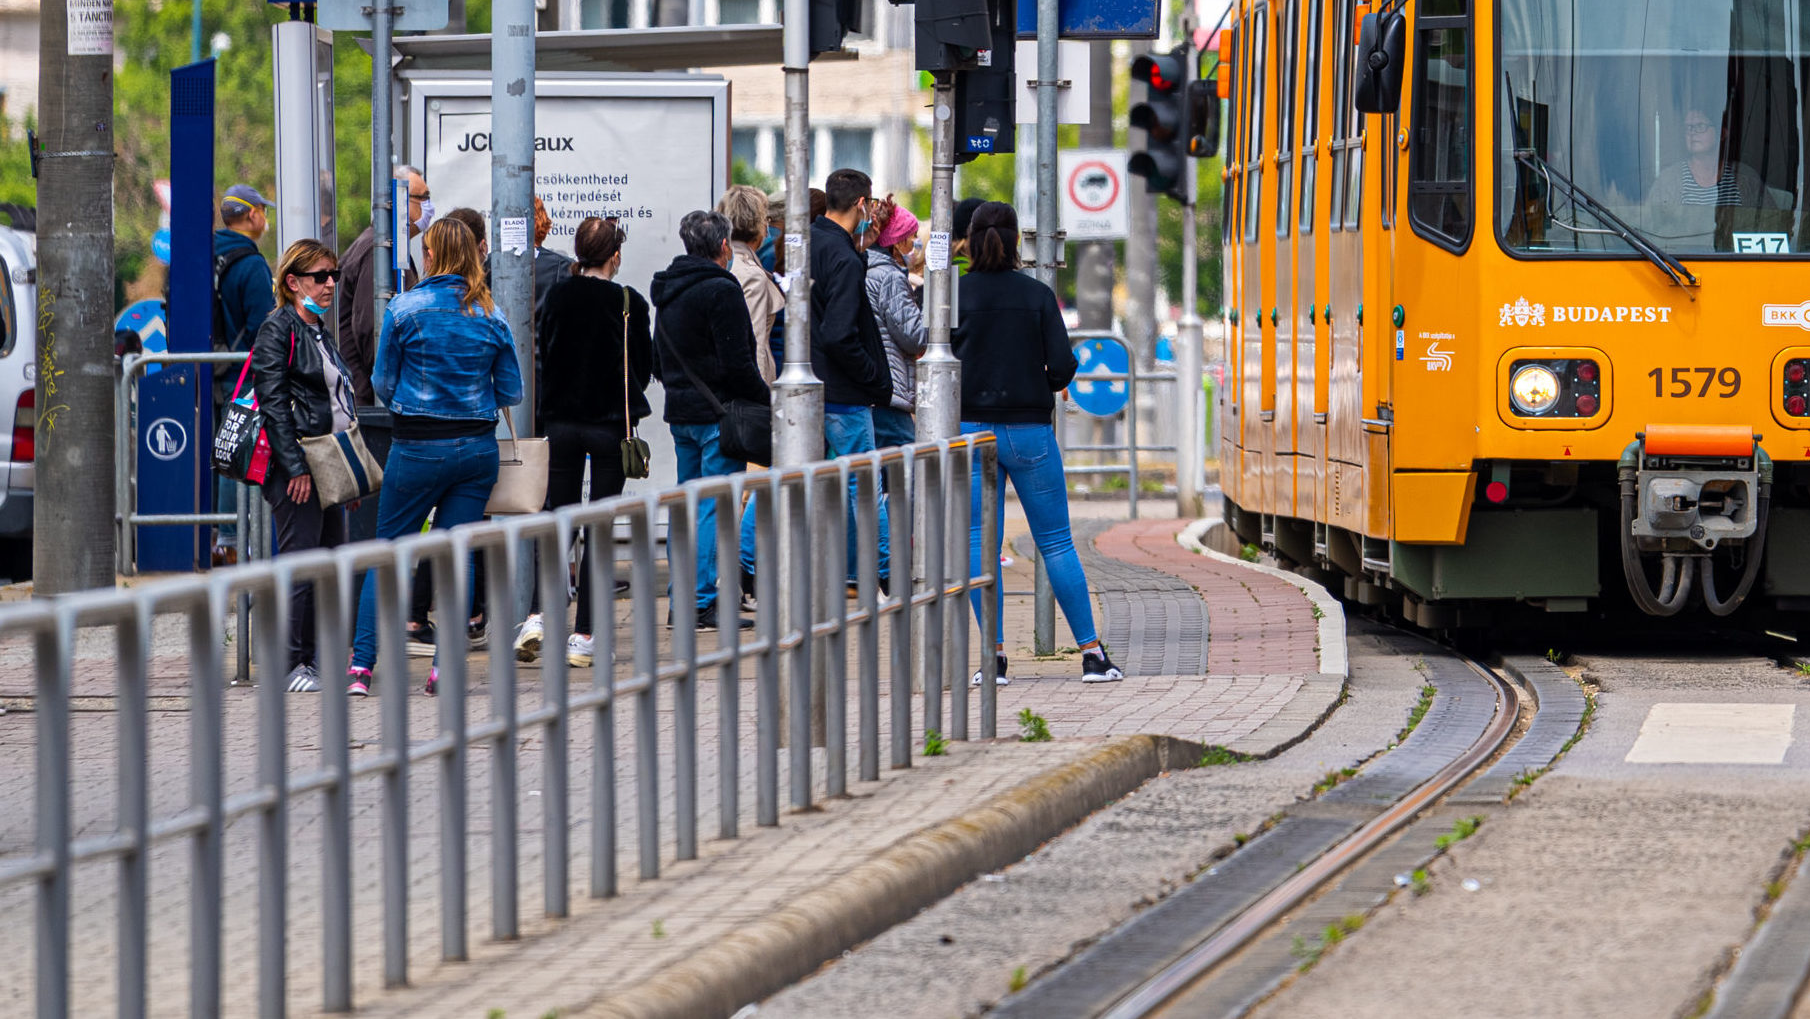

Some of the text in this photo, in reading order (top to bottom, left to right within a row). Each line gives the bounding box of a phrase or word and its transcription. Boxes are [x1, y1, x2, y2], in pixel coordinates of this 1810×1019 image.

[457, 132, 574, 152] JCaux
[536, 173, 628, 185] csökkentheted
[557, 190, 622, 204] terjedését
[638, 207, 652, 218] és
[1553, 307, 1672, 323] BUDAPEST
[1771, 311, 1797, 320] BKK
[1648, 368, 1741, 399] 1579
[215, 448, 231, 462] LOOK
